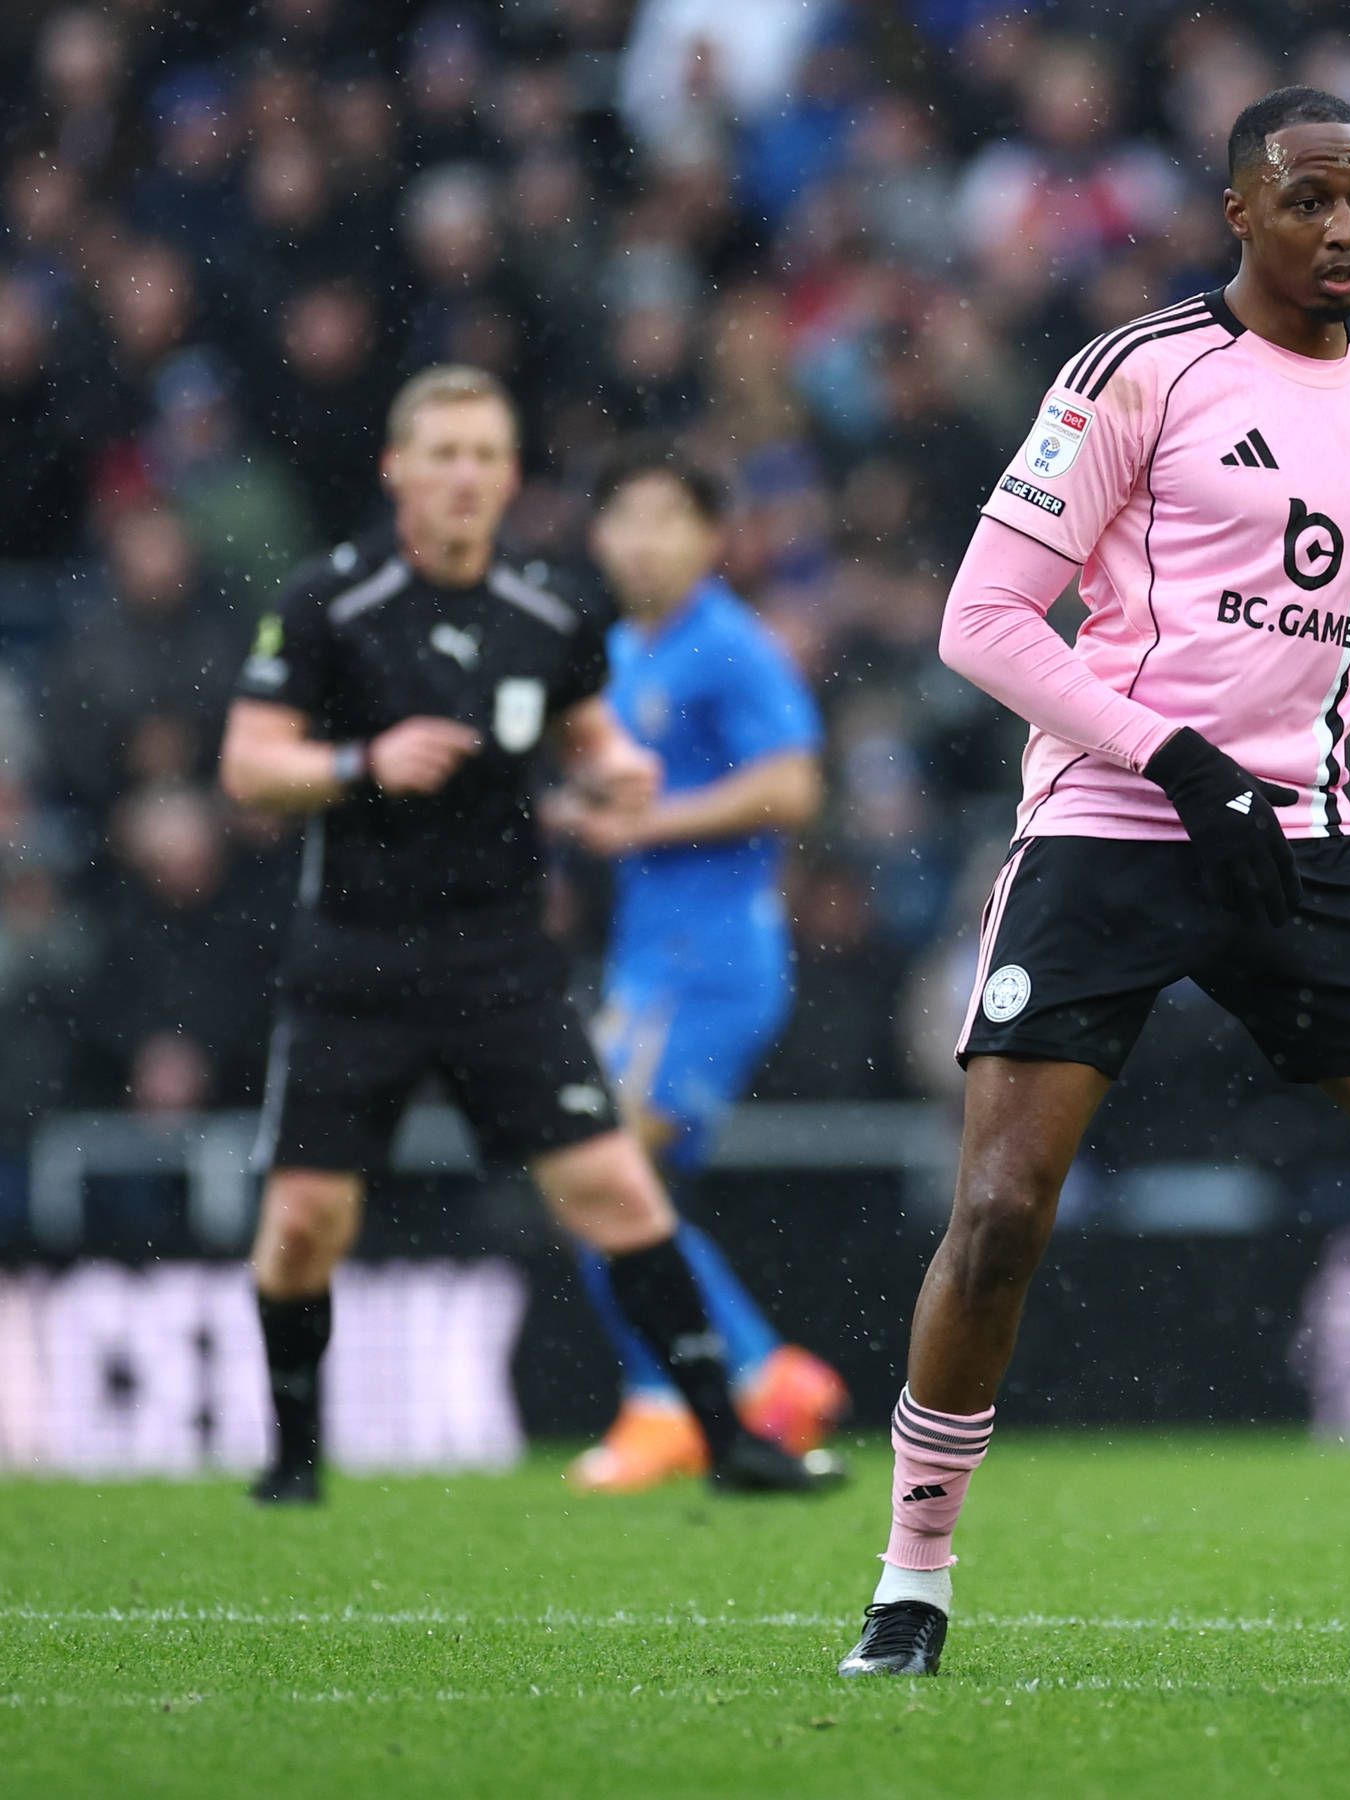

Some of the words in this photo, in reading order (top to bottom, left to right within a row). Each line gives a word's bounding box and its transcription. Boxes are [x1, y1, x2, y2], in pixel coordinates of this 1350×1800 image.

[1047, 404, 1063, 418] sky
[1063, 411, 1083, 428] bet
[1034, 458, 1050, 472] EFL
